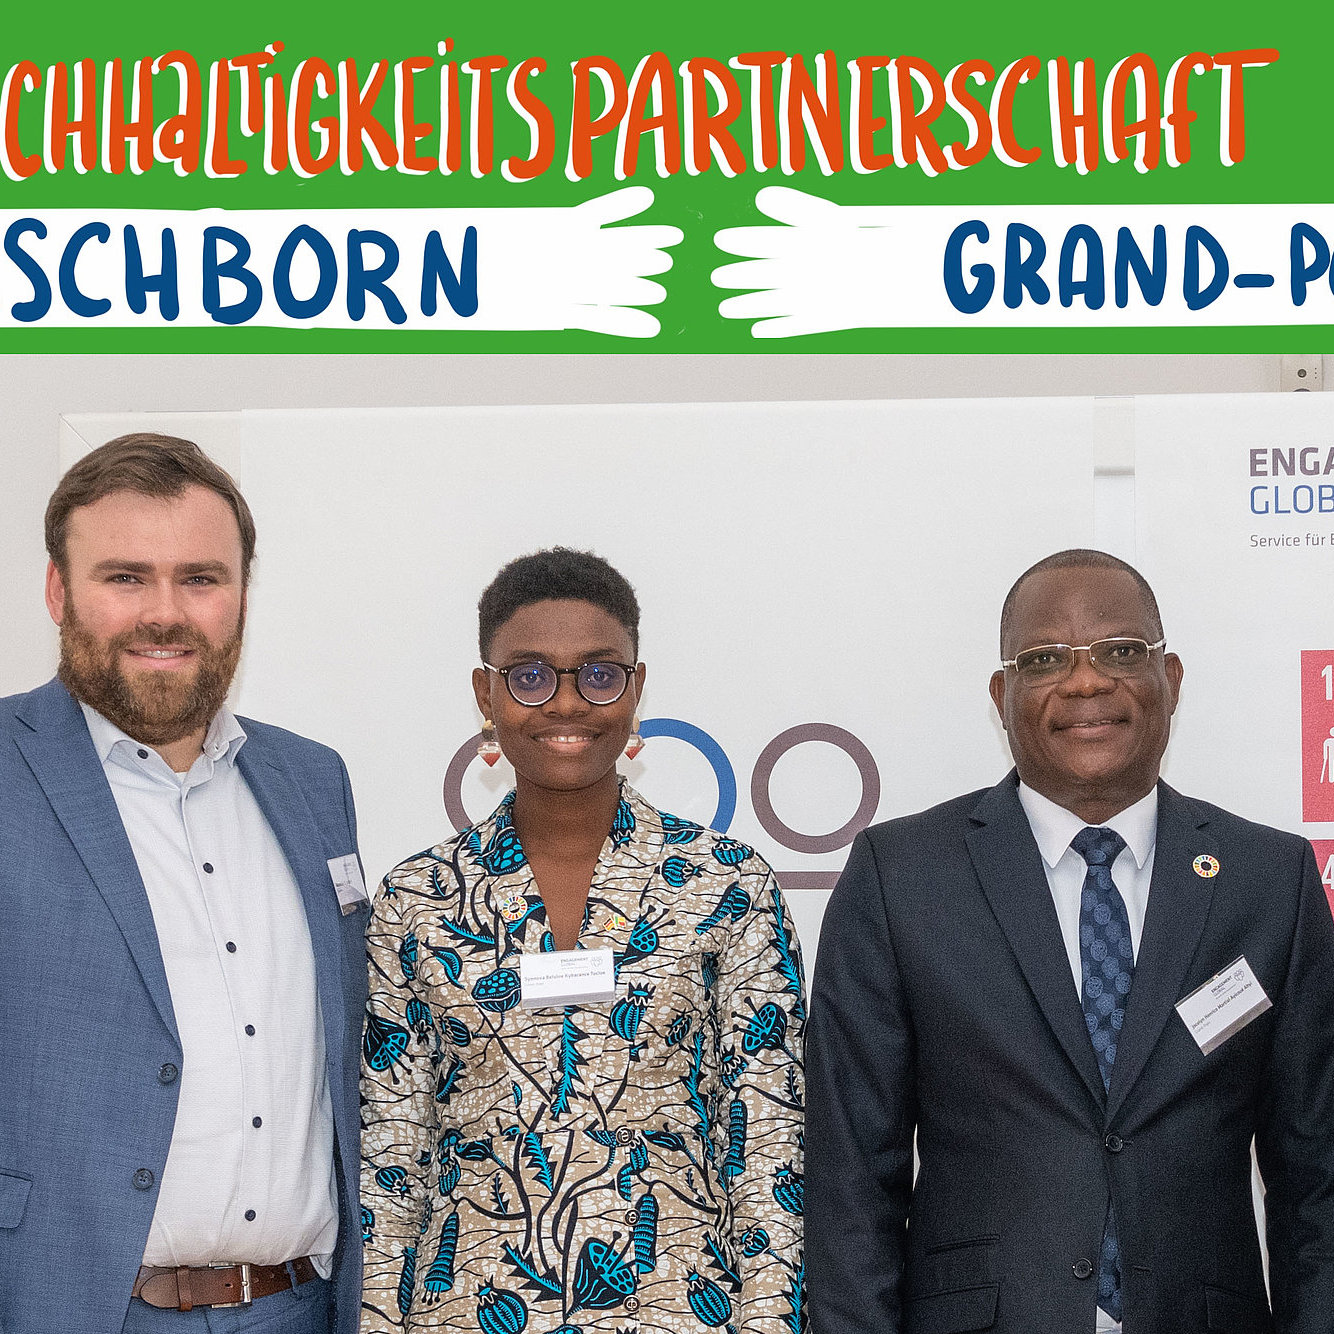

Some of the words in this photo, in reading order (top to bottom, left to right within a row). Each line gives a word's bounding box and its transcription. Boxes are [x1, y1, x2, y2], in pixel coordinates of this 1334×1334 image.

[1250, 533, 1301, 548] Service
[1305, 532, 1326, 547] für
[1321, 664, 1333, 700] 1
